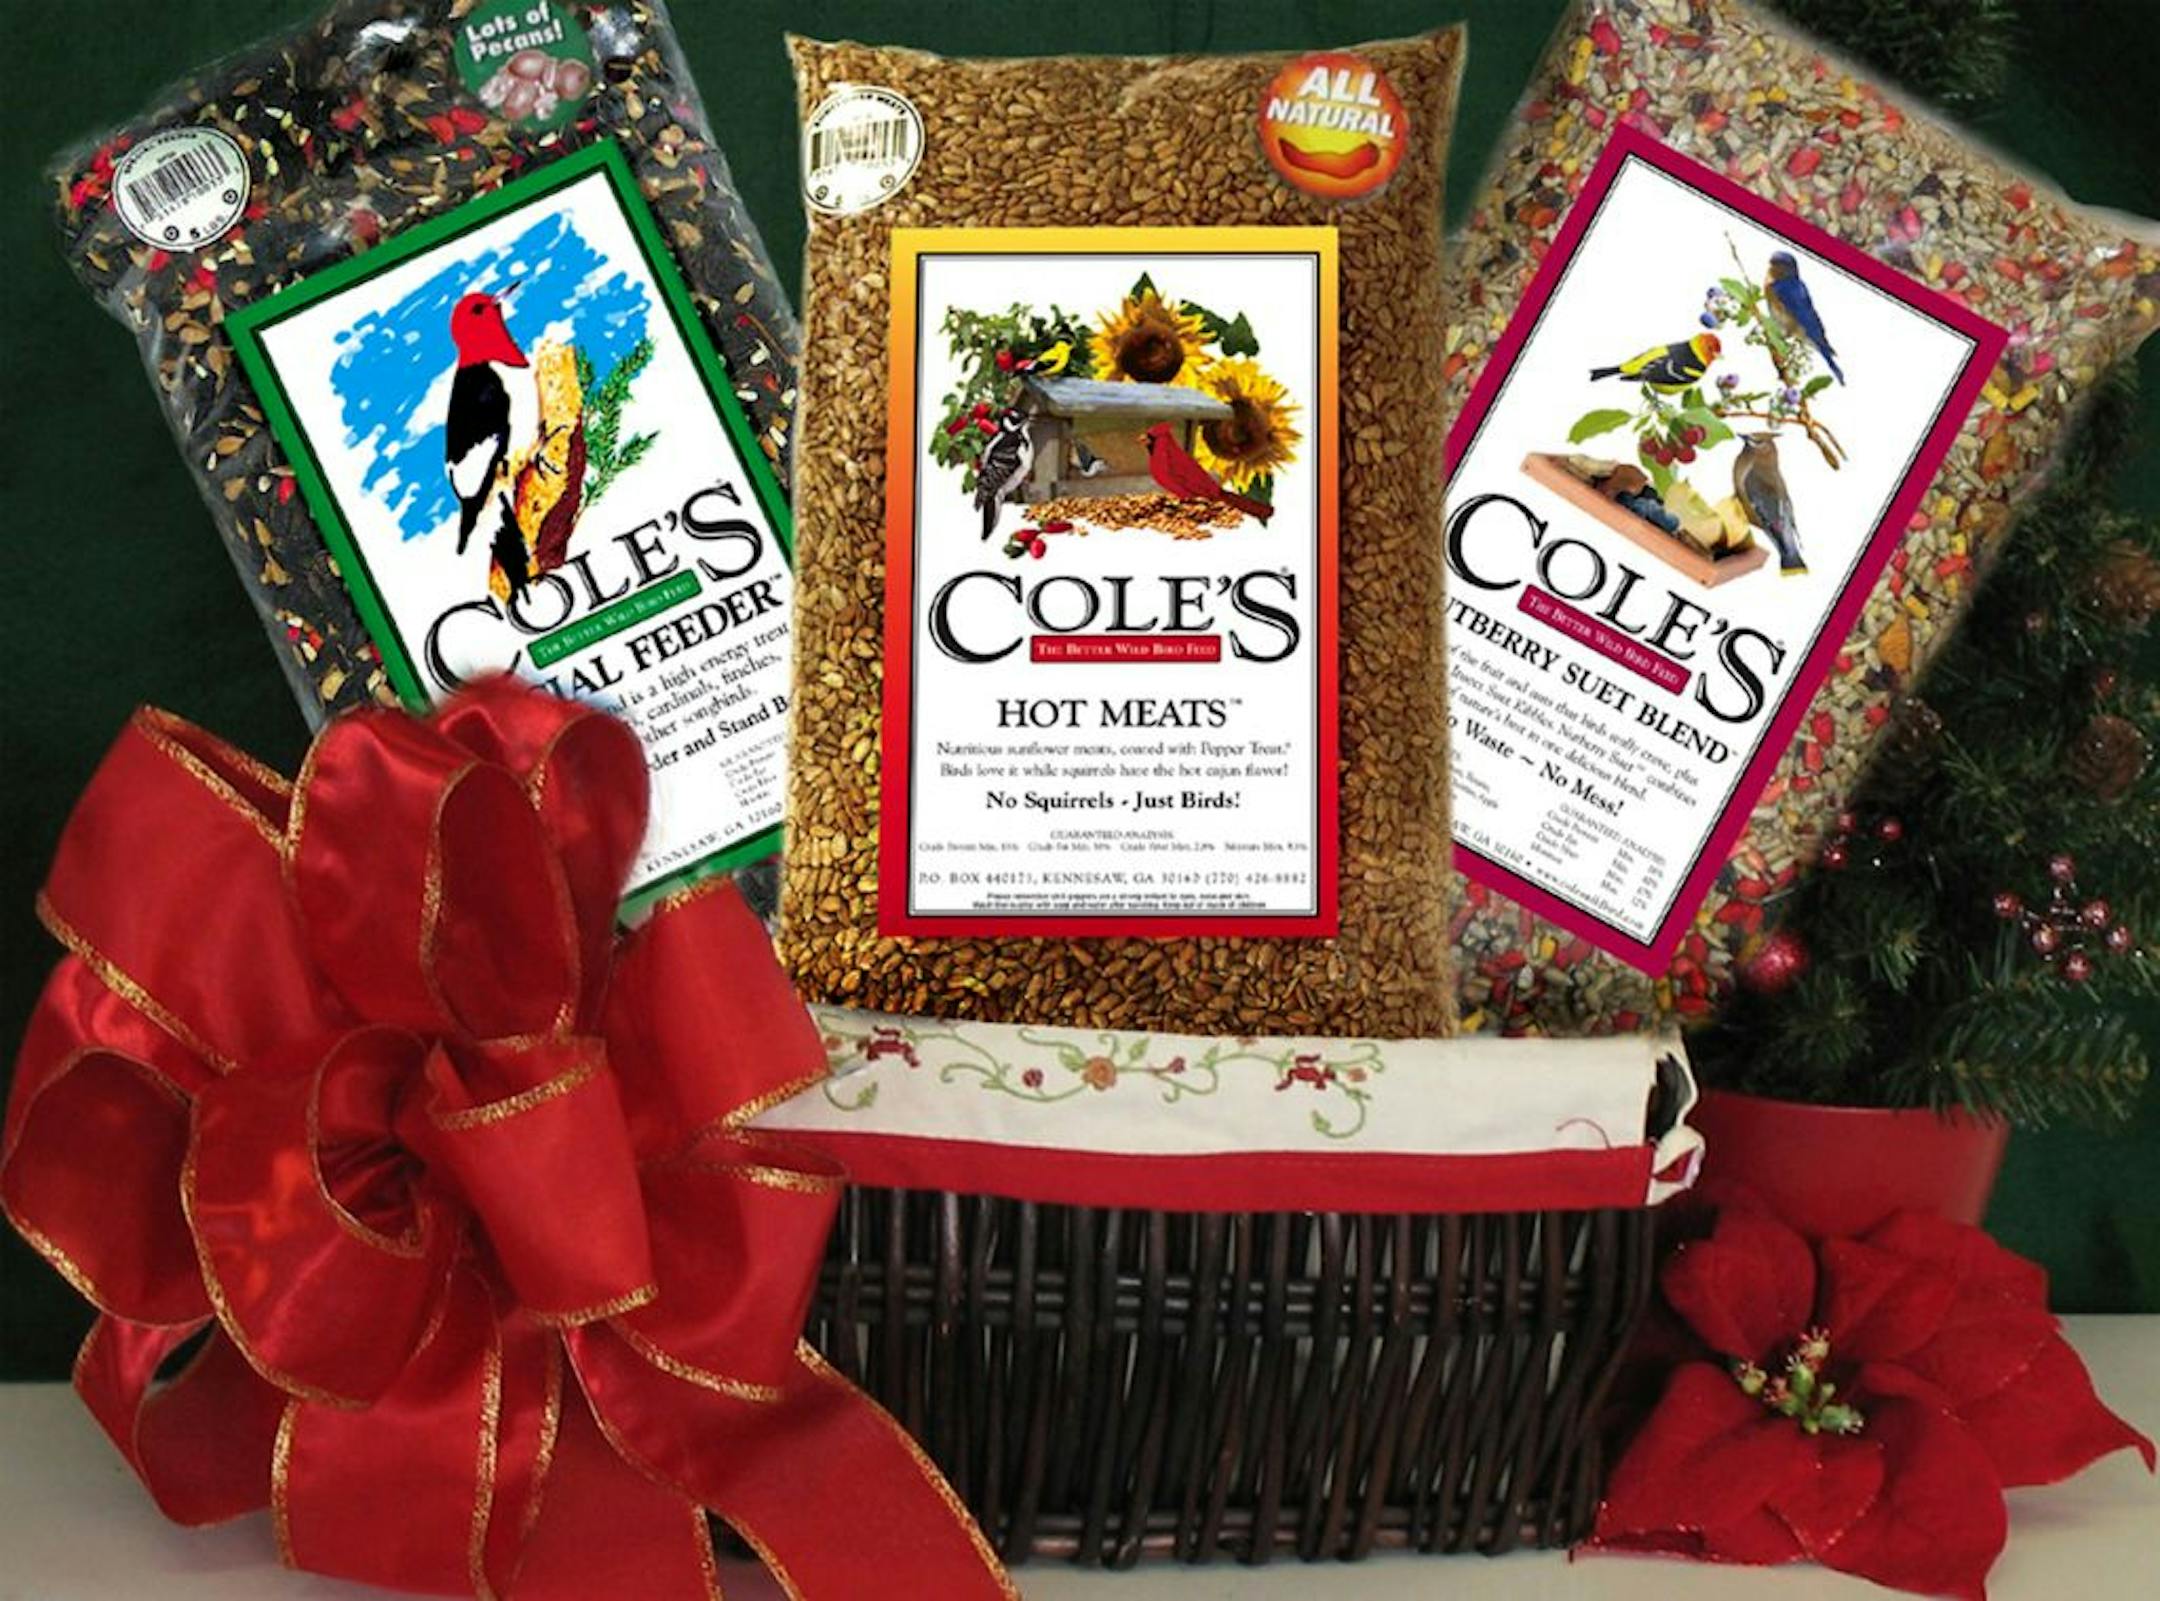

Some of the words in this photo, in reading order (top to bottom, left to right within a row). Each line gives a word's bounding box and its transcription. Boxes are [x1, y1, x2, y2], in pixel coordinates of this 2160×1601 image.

[465, 14, 518, 43] Lots
[525, 0, 550, 25] of
[469, 18, 564, 63] Pecans!
[1297, 66, 1381, 107] ALL
[1266, 97, 1395, 139] NATURAL
[425, 481, 763, 694] COLE'S
[1443, 493, 1787, 723] COLE'S
[625, 579, 784, 672] FEEDER
[928, 570, 1300, 664] COLE'S
[631, 691, 645, 704] is
[649, 685, 658, 698] a
[659, 664, 697, 691] high
[700, 641, 750, 672] energy
[647, 678, 720, 720] cardinals,
[722, 653, 782, 685] finches,
[1446, 597, 1561, 673] TBERRY
[1561, 661, 1636, 714] SUET
[1635, 702, 1729, 764] BLEND
[683, 727, 716, 757] and
[718, 703, 770, 739] Stand
[996, 699, 1088, 728] HOT
[936, 741, 1002, 756] Nutritious
[1007, 741, 1070, 756] sunflower
[1119, 741, 1164, 755] coated
[1168, 741, 1197, 756] with
[1201, 741, 1246, 757] Pepper
[940, 762, 973, 777] Birds
[977, 763, 1004, 777] love
[1009, 763, 1018, 777] it
[1023, 763, 1057, 777] while
[1062, 763, 1116, 779] squirrels
[1153, 763, 1175, 777] the
[1179, 763, 1201, 777] hot
[1206, 764, 1241, 779] cajun
[1466, 718, 1515, 758] Waste
[1539, 760, 1568, 787] No
[1570, 777, 1624, 817] Mess!
[986, 790, 1018, 809] No
[1024, 790, 1114, 813] Squirrels
[1132, 790, 1174, 812] Just
[1181, 790, 1241, 809] Birds!
[950, 872, 980, 884] BOX
[1132, 872, 1155, 884] GA
